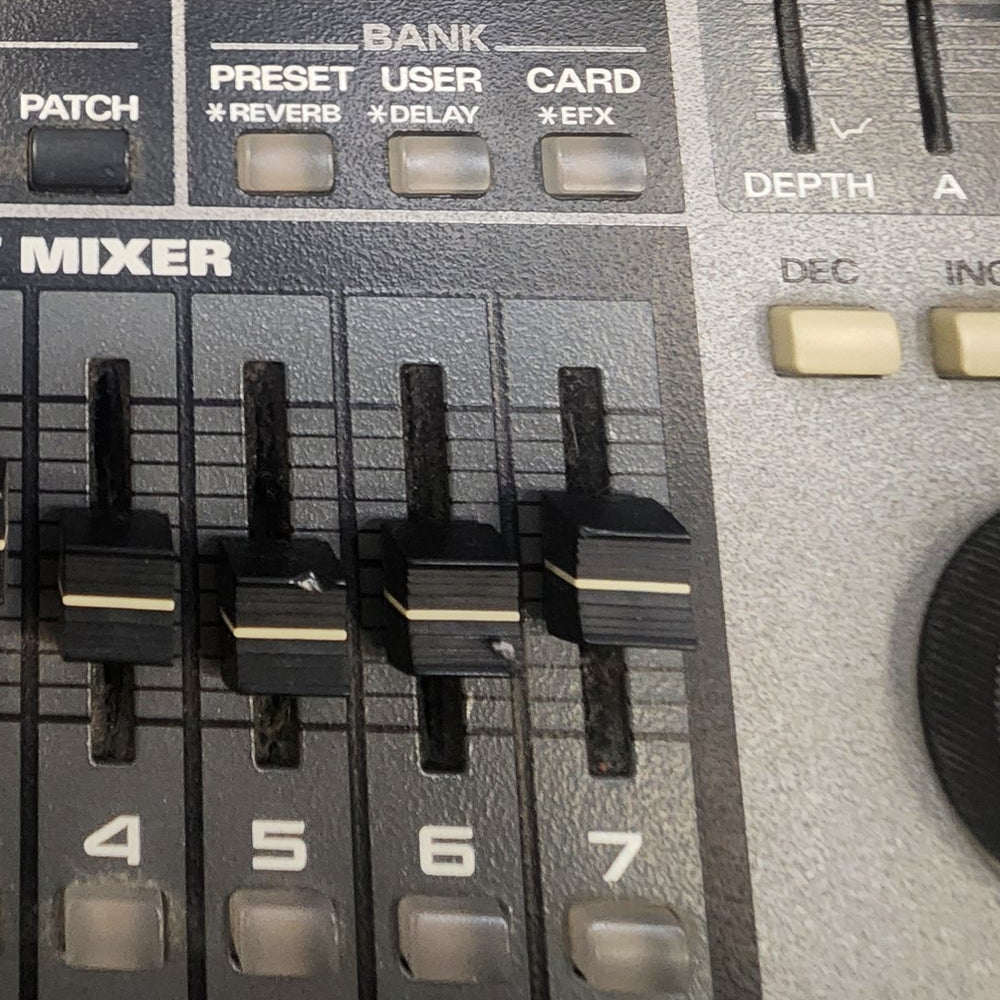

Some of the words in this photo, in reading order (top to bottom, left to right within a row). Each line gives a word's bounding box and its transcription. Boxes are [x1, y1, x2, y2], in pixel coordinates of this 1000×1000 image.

[362, 24, 491, 52] BANK
[210, 65, 354, 92] PRESET
[381, 66, 482, 93] USER
[526, 67, 641, 94] CARD
[20, 94, 139, 121] PATCH
[744, 172, 875, 199] DEPTH
[932, 172, 968, 200] A
[20, 236, 232, 277] MIXER
[781, 257, 860, 284] DEC
[83, 815, 141, 866] 4
[252, 819, 307, 872] 5
[418, 825, 476, 877] 6
[587, 831, 643, 882] 7
